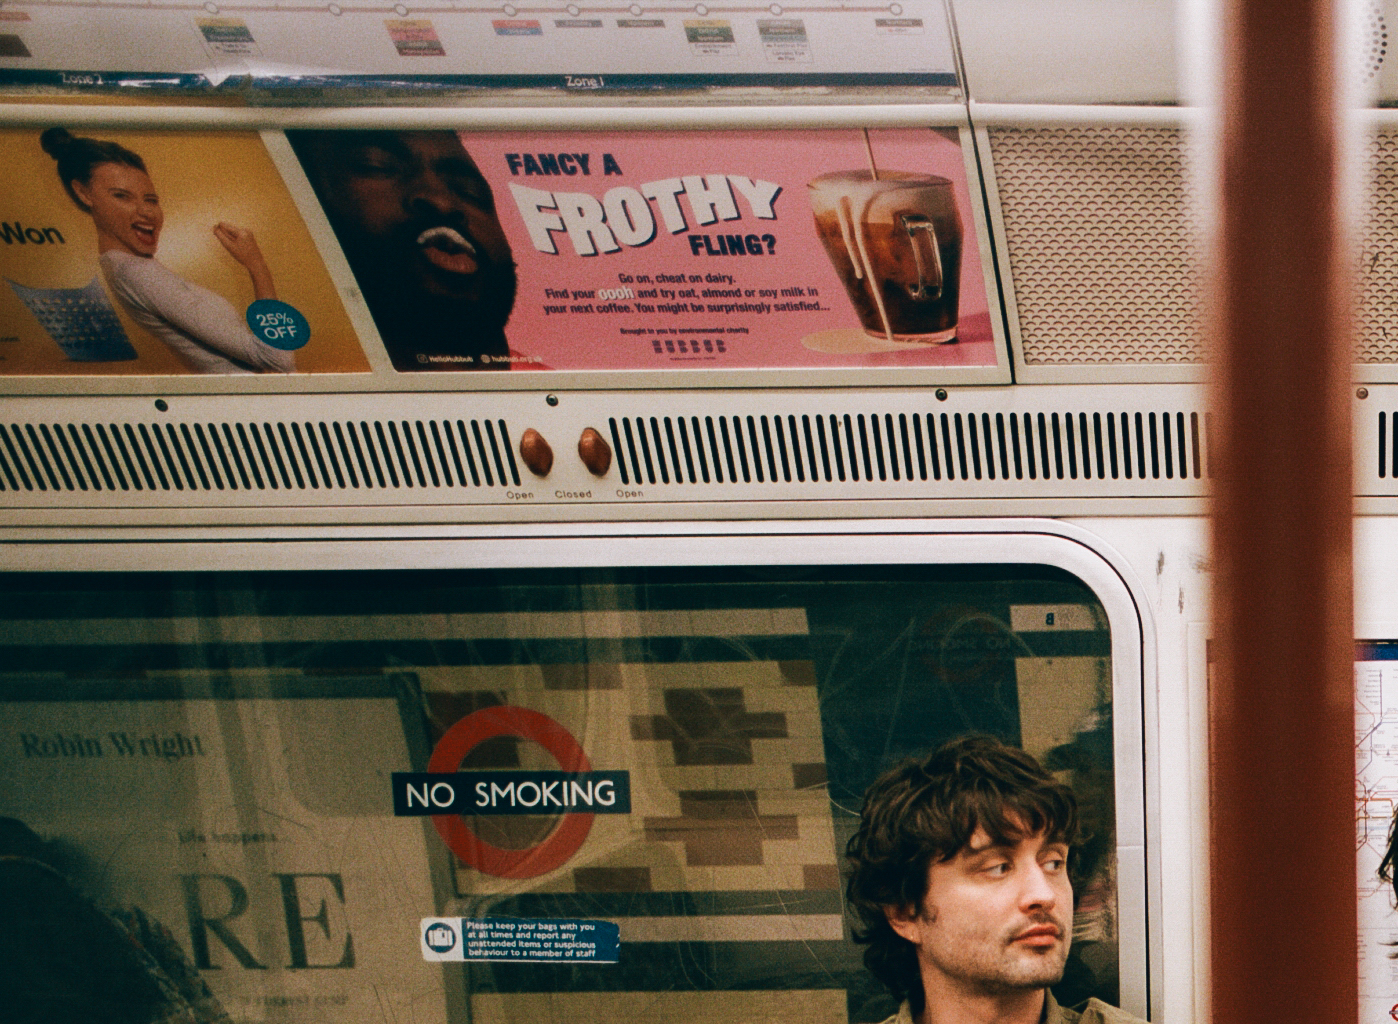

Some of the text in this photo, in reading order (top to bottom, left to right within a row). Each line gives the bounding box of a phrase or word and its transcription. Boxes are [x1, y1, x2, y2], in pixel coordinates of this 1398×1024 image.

[565, 76, 597, 87] Zone
[504, 153, 623, 176] FANCY A
[508, 174, 783, 257] FROTHY
[1, 221, 65, 246] Won
[687, 234, 776, 256] FLING?
[619, 273, 737, 286] Go on, cheat on dairy.
[545, 286, 818, 301] Find your oooh and try oat, almond or soy milk in
[543, 304, 568, 316] your
[570, 303, 595, 314] next
[595, 302, 634, 314] coffee.
[634, 302, 655, 313] You
[657, 302, 689, 315] might
[690, 302, 705, 313] be
[707, 301, 771, 315] surprisingly
[256, 312, 294, 327] 25%
[264, 325, 297, 340] OFF
[506, 489, 644, 500] Open Closed Open
[20, 731, 204, 763] Robin Wright
[406, 780, 615, 808] NO SMOKING
[466, 921, 596, 932] Please keep your bags with you
[467, 931, 576, 941] at all times and report any
[468, 940, 517, 948] unattended
[518, 940, 541, 948] items
[554, 940, 596, 950] suspicious
[468, 948, 509, 957] behaviour
[510, 949, 520, 957] to
[529, 949, 563, 957] member
[565, 949, 574, 957] of
[575, 949, 596, 957] staff
